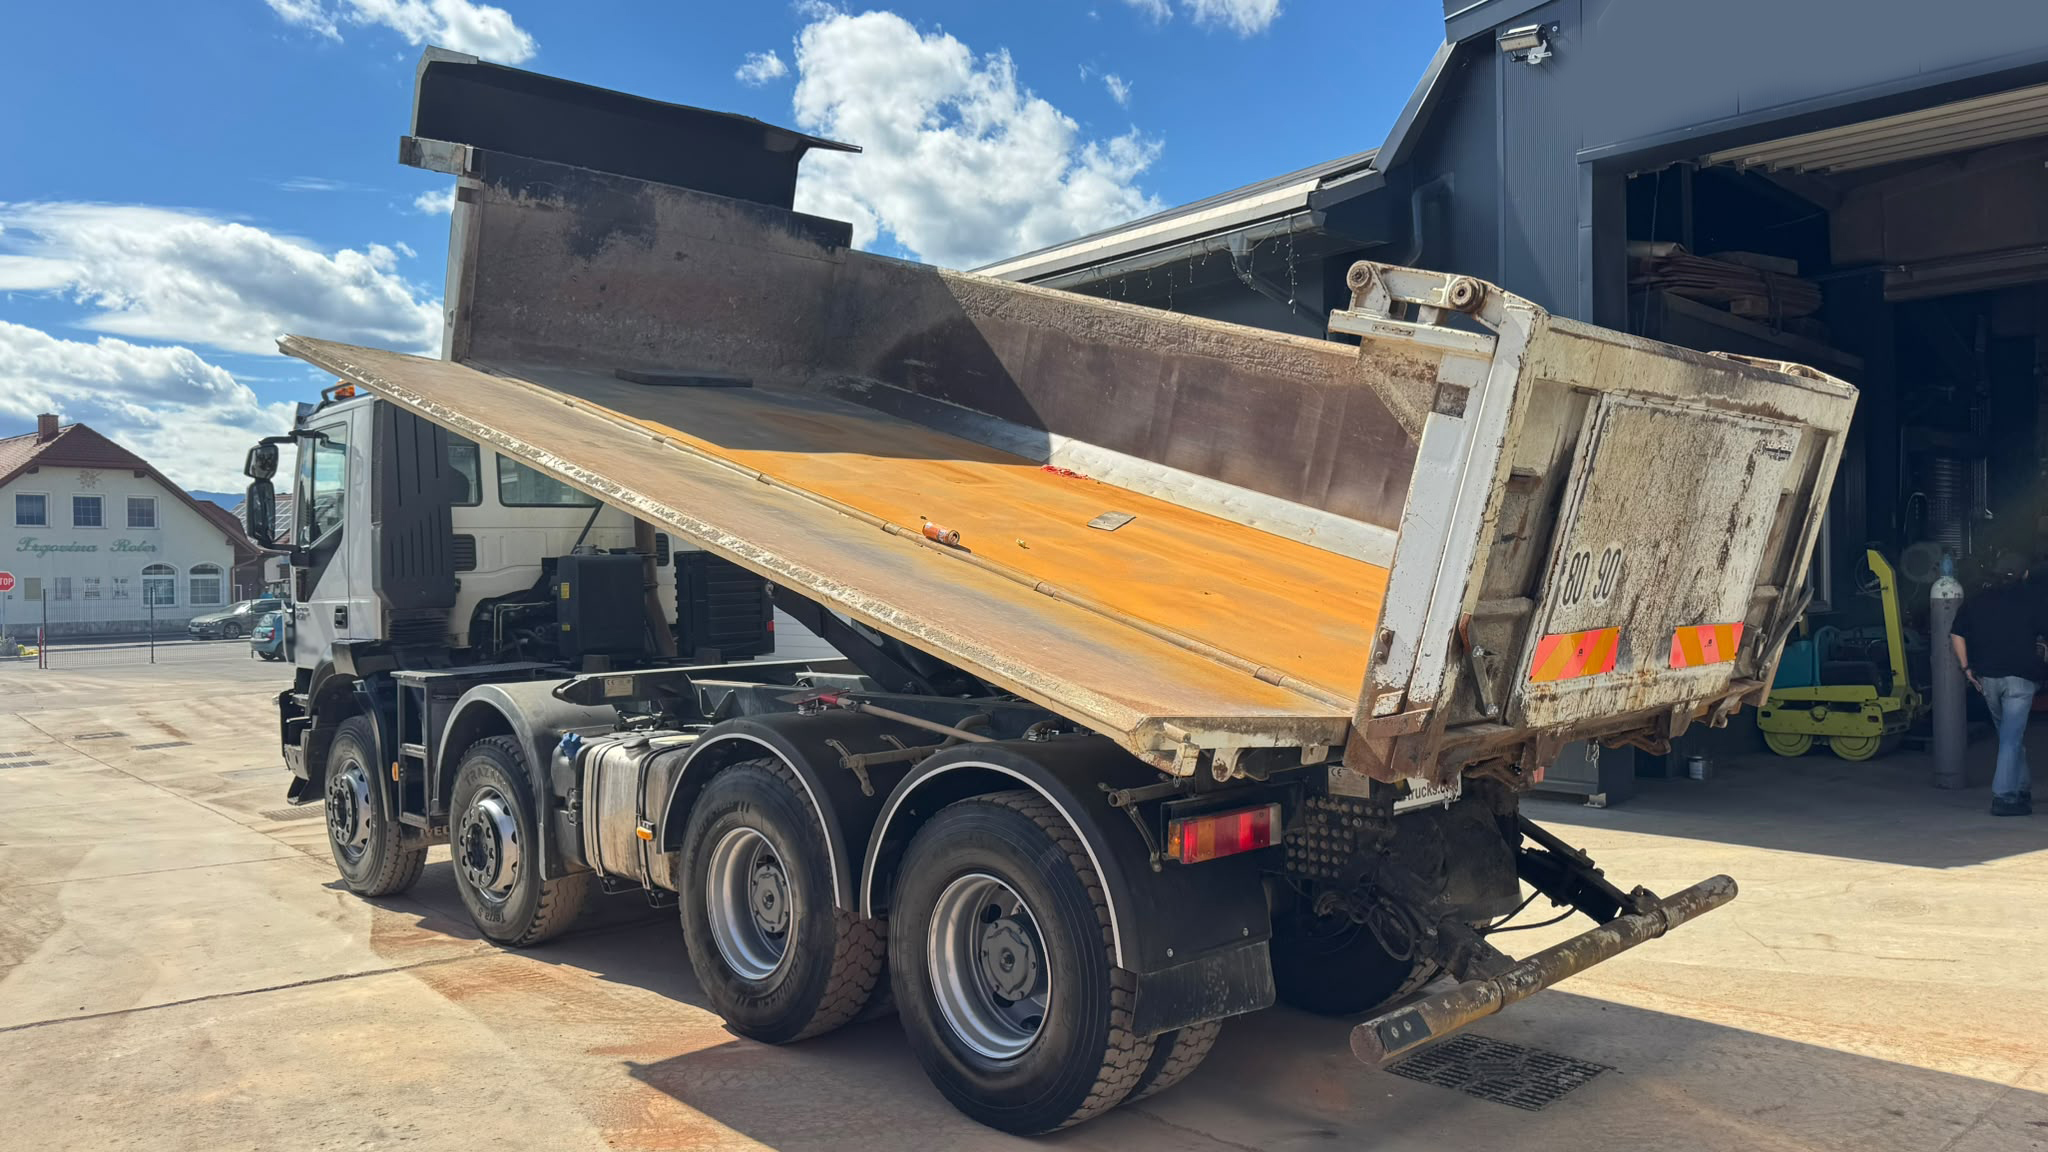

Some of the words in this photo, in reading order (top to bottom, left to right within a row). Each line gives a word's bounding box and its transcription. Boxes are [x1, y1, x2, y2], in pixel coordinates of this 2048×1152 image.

[0, 577, 13, 586] TOP
[1562, 552, 1590, 606] 80
[1593, 548, 1621, 600] 90
